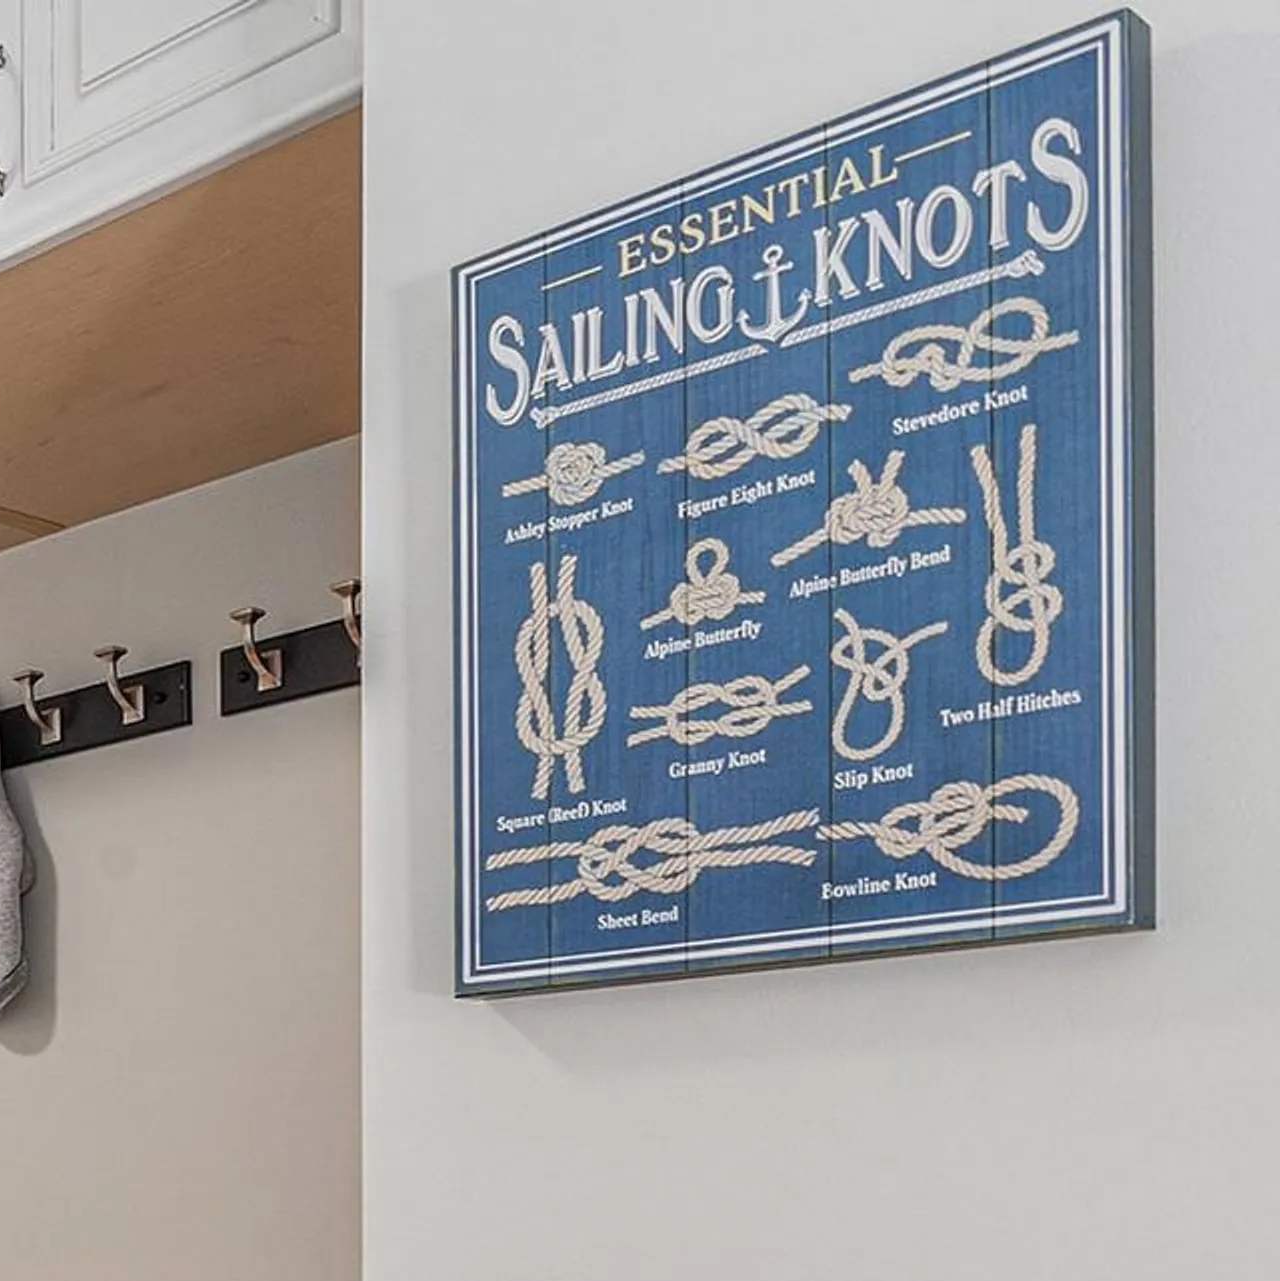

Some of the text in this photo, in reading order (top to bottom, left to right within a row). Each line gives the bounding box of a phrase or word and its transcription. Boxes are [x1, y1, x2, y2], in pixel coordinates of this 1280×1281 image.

[617, 144, 898, 278] ESSENTIAL
[486, 117, 1089, 427] SAILING KNOTS
[892, 385, 1028, 436] Stevedore Knot
[678, 469, 816, 519] Figure Eight Knot
[504, 498, 633, 544] Ashley Stopper Knot
[790, 544, 951, 599] Alpine Butterfly Bend
[644, 620, 762, 661] Alpine Butterfly
[940, 690, 1081, 728] Two Half Hitches
[669, 749, 766, 779] Granny Knot
[834, 763, 914, 790] Slip Knot
[496, 799, 627, 833] Square (Reef) Knot
[821, 872, 937, 899] Bowline Knot
[598, 906, 679, 929] Sheet Bend
